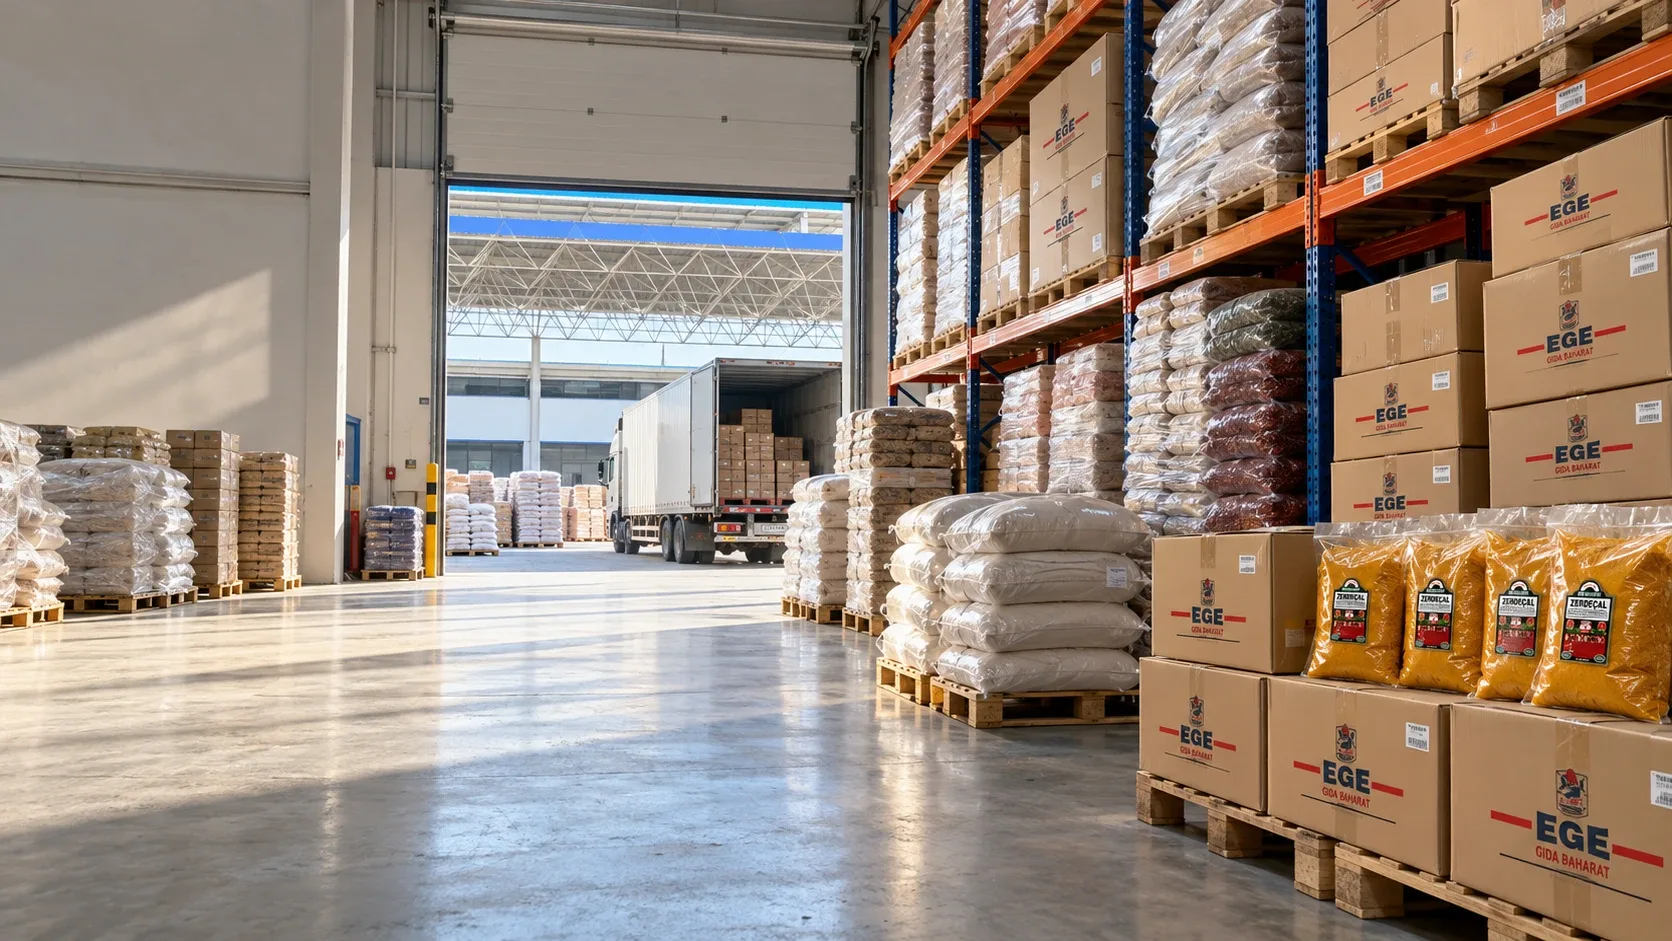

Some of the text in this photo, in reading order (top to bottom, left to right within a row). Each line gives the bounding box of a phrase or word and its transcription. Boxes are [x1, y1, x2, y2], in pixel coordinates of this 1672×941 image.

[1370, 88, 1392, 108] EGE
[1056, 117, 1075, 142] EGE
[1550, 193, 1590, 222] EGE
[1056, 210, 1074, 232] EGE
[1546, 325, 1593, 354] EGE
[1376, 404, 1407, 423] EGE
[1556, 440, 1600, 464] EGE
[1374, 496, 1406, 512] EGE
[1192, 606, 1224, 626] EGE
[1570, 599, 1607, 610] ZERDEÇAL
[1180, 724, 1213, 750] EGE
[1323, 760, 1370, 794] EGE
[1536, 810, 1610, 860] EGE
[1536, 846, 1610, 879] GIDA BAHARAT
